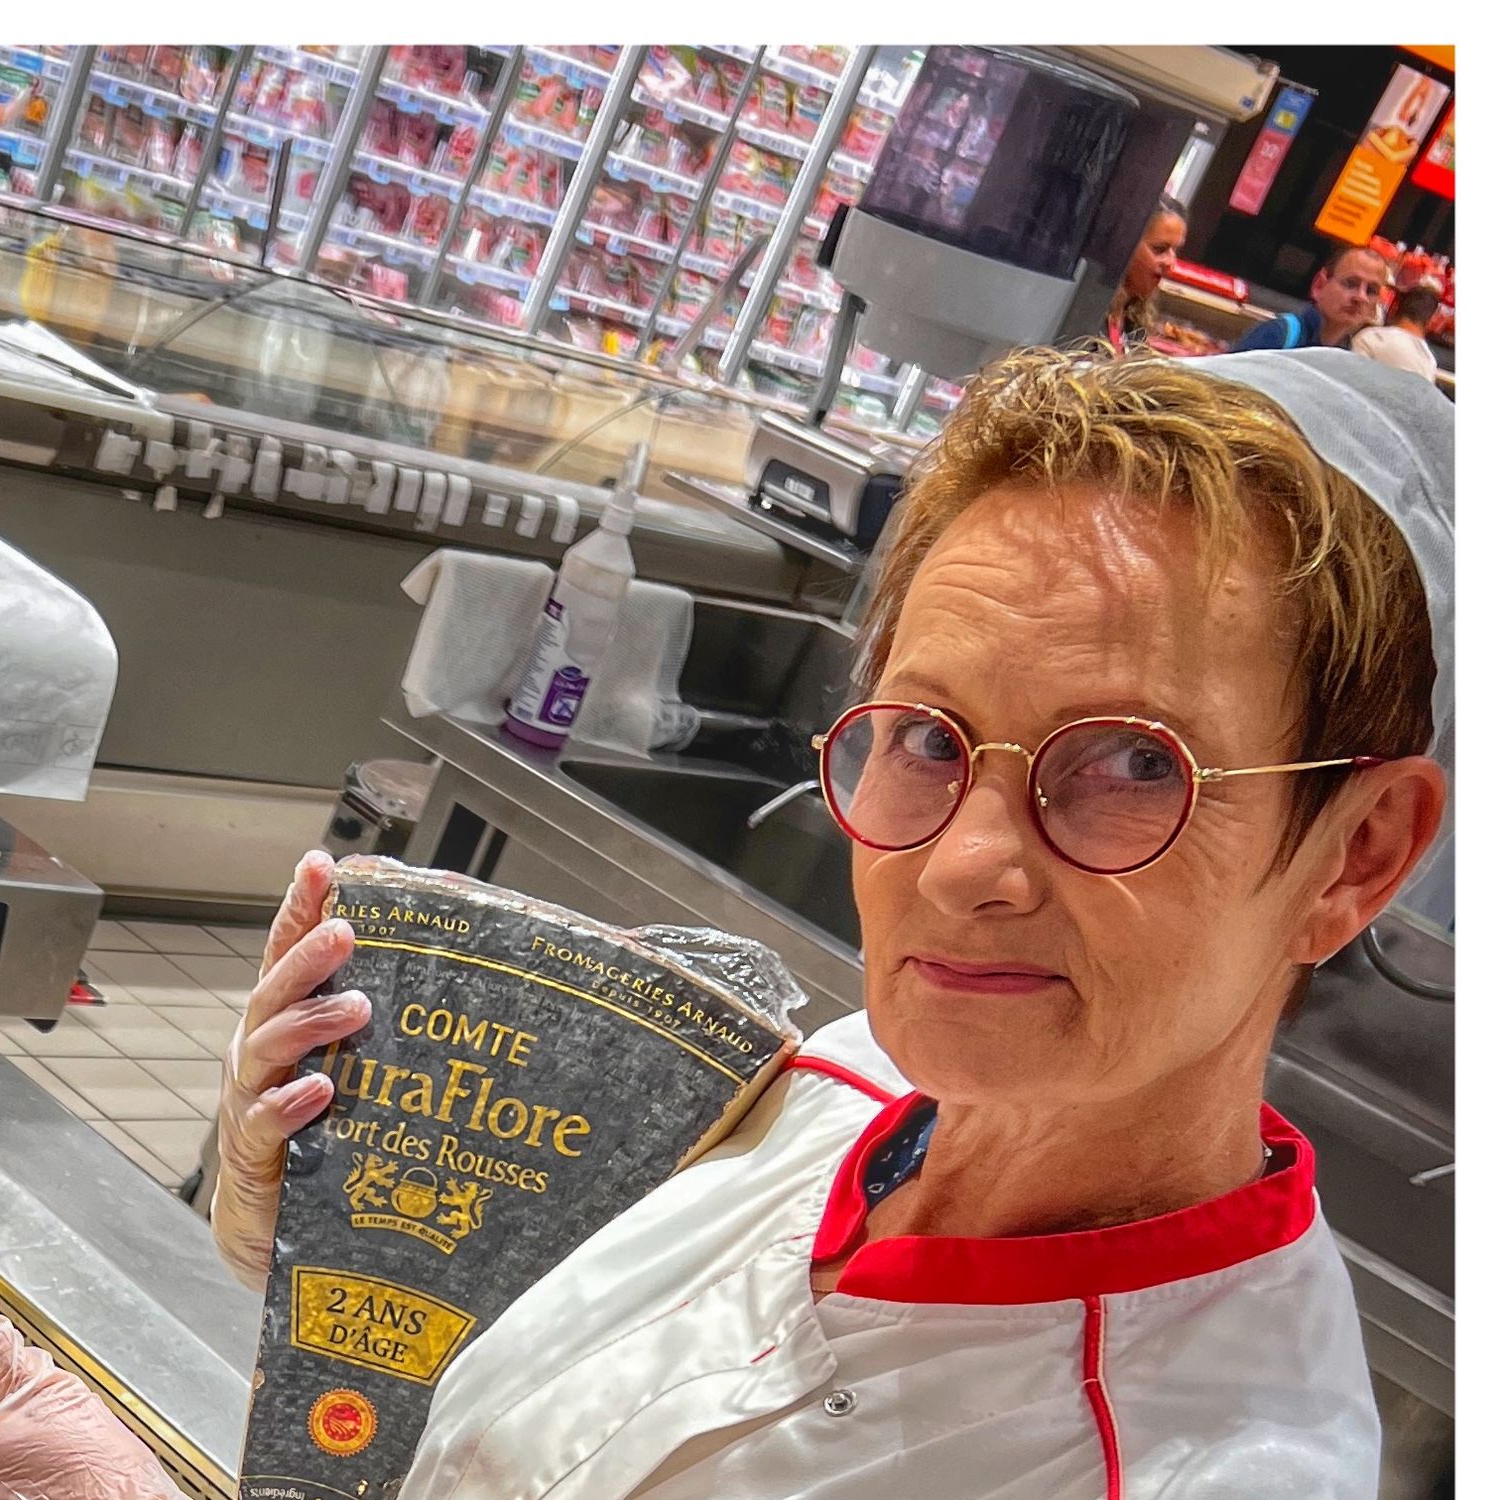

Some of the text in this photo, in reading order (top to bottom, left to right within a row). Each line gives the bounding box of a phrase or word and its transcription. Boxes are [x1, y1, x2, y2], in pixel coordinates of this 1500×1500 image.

[387, 906, 471, 934] ARNAUD
[531, 935, 675, 1007] FROMAGERIES
[677, 1000, 753, 1054] ARNAUD
[648, 1005, 682, 1029] 1907
[382, 1122, 432, 1161] des
[435, 1134, 549, 1195] Rousses
[367, 1215, 398, 1228] TEMPS
[401, 1221, 418, 1233] EST
[326, 1287, 428, 1338] 2 ANS
[328, 1320, 408, 1365] D'ÂGE
